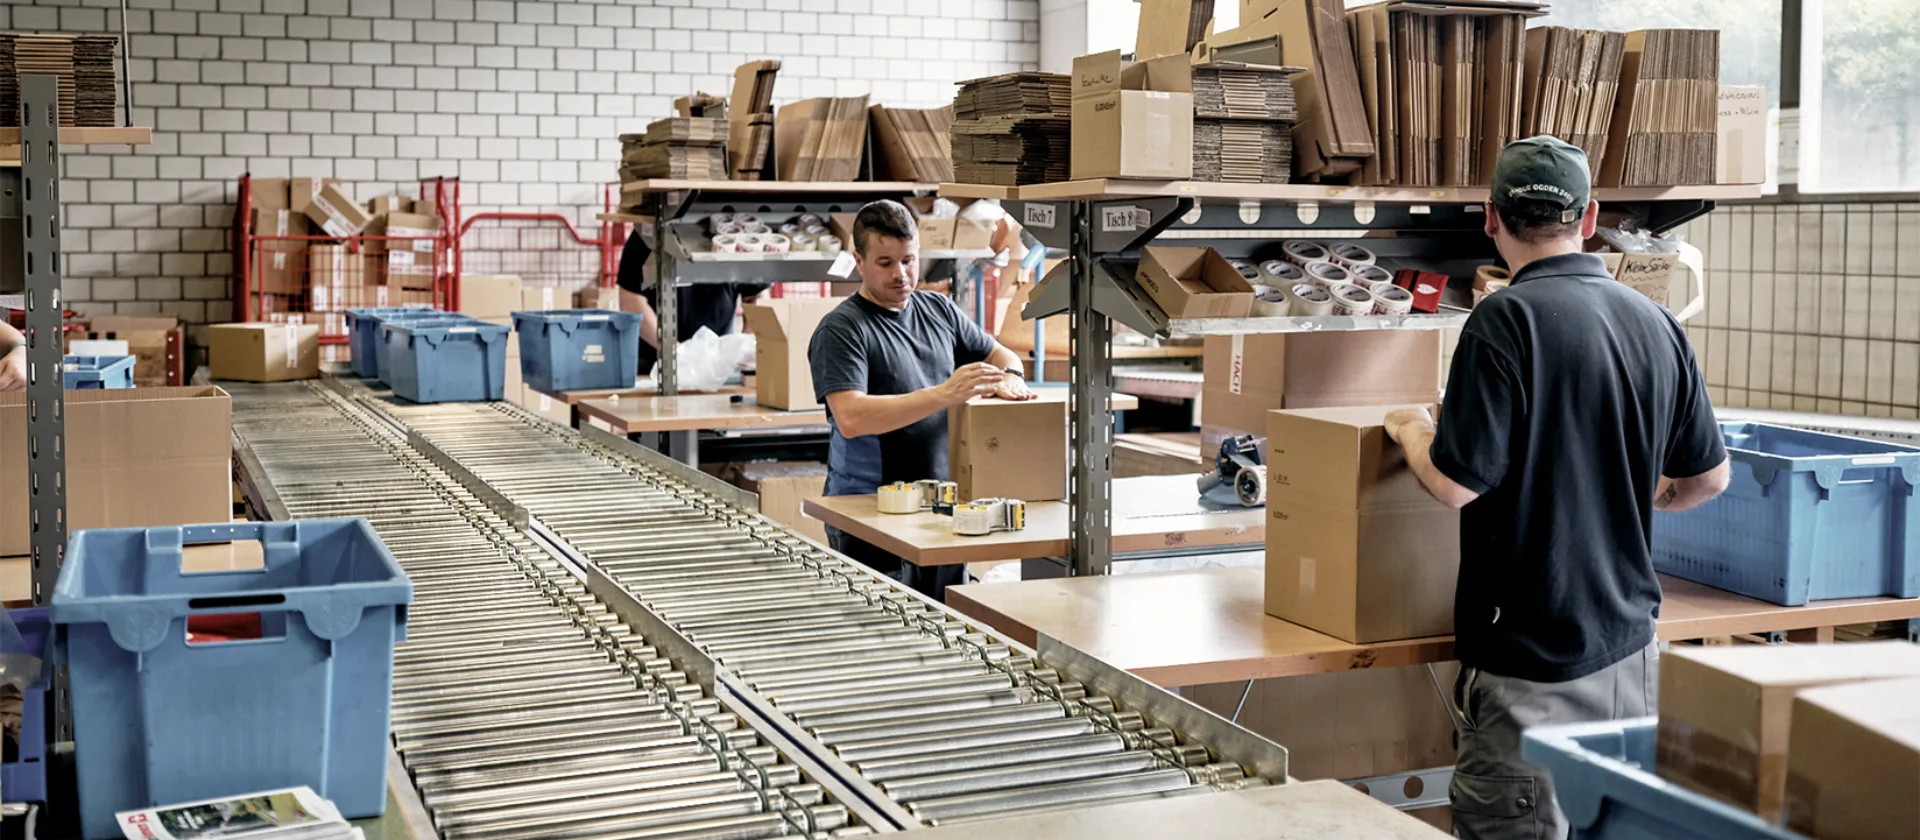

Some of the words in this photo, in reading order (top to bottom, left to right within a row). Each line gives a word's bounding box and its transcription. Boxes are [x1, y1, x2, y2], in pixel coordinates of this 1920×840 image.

[1532, 183, 1559, 194] OGDEN
[1028, 207, 1046, 222] Tisch
[1047, 209, 1053, 225] 7
[1106, 211, 1126, 228] Tisch
